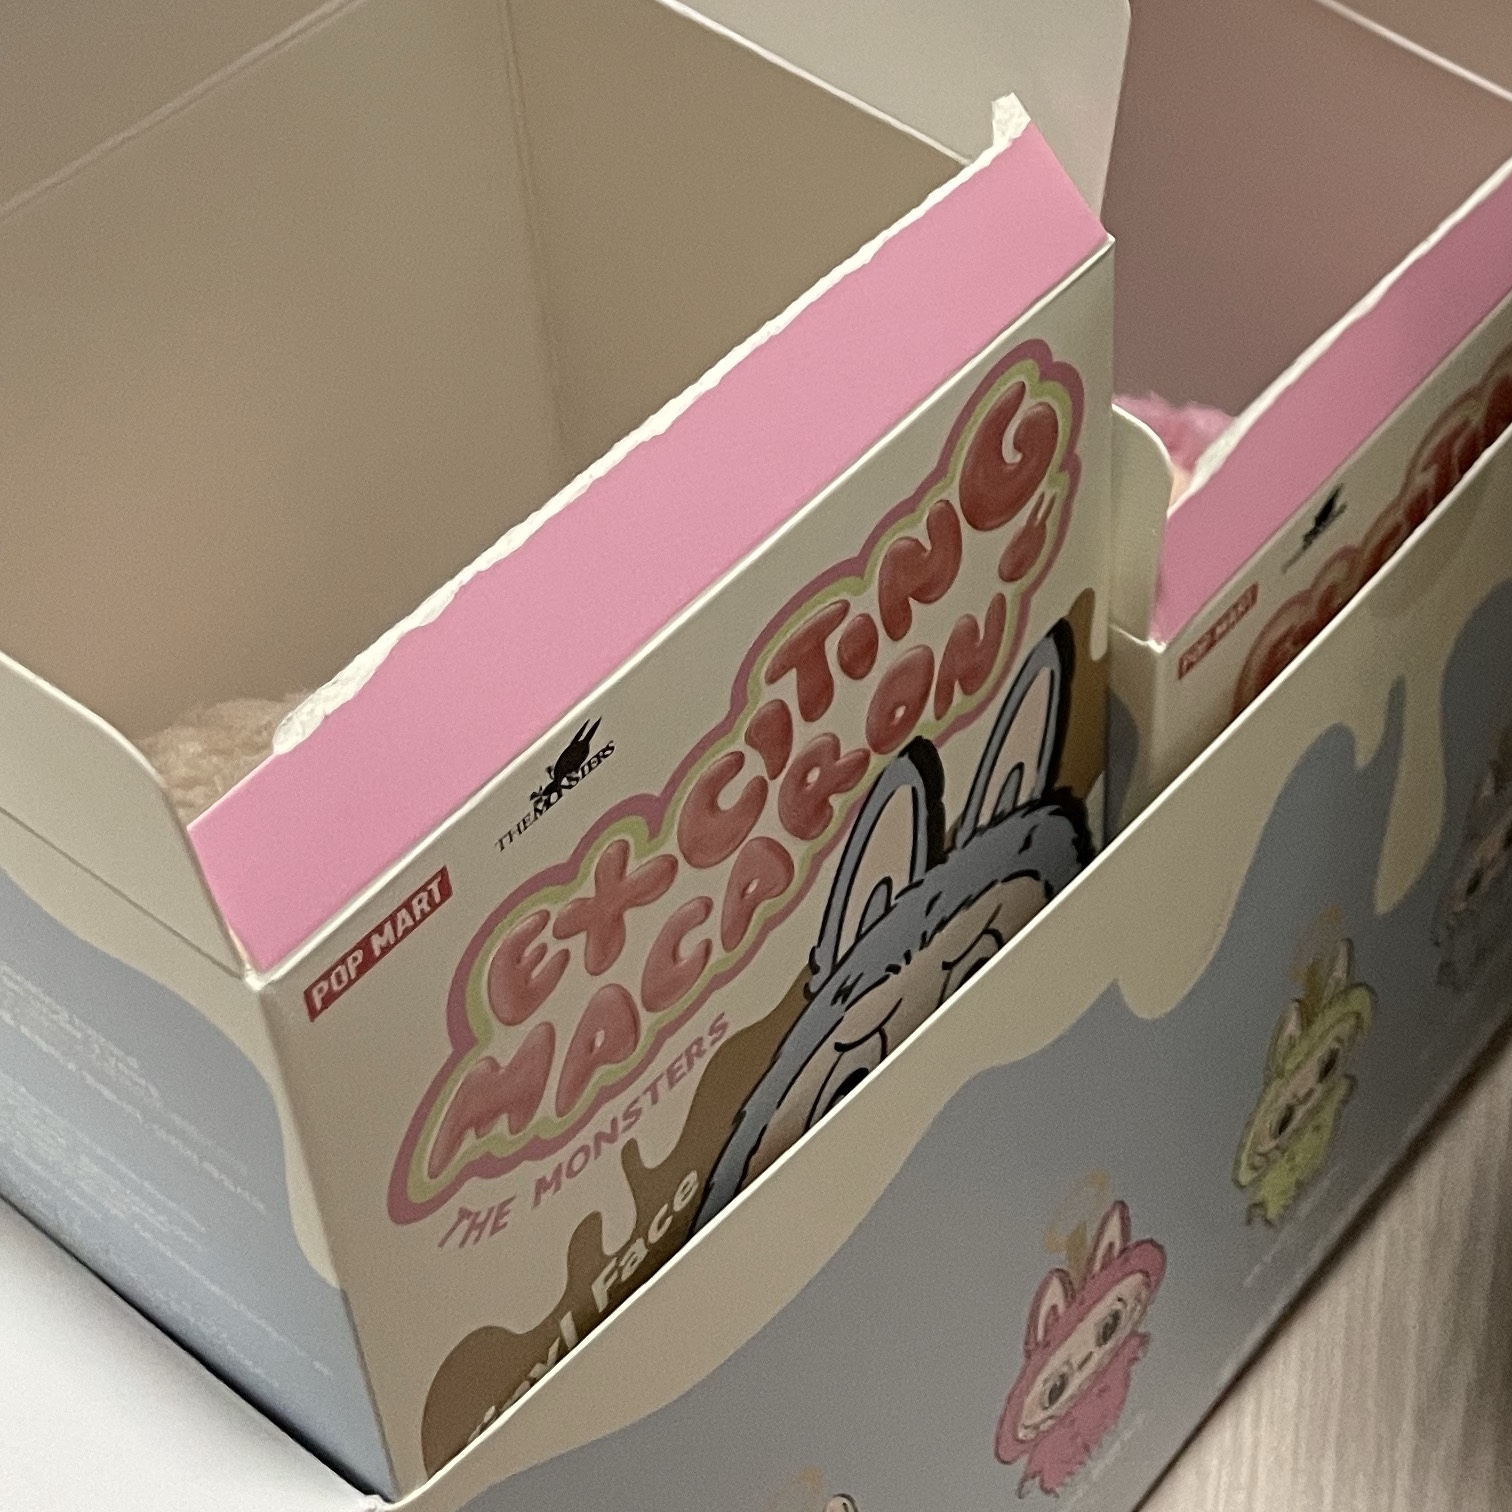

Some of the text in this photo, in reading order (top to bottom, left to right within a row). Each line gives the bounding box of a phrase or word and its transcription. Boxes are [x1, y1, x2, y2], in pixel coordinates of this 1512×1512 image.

[487, 380, 1059, 1026] EXCITING
[311, 874, 442, 1011] POP MART
[427, 592, 1008, 1179] MACARON
[437, 1195, 517, 1249] THE
[532, 1011, 729, 1210] MONSTERS
[591, 1170, 699, 1313] Face
